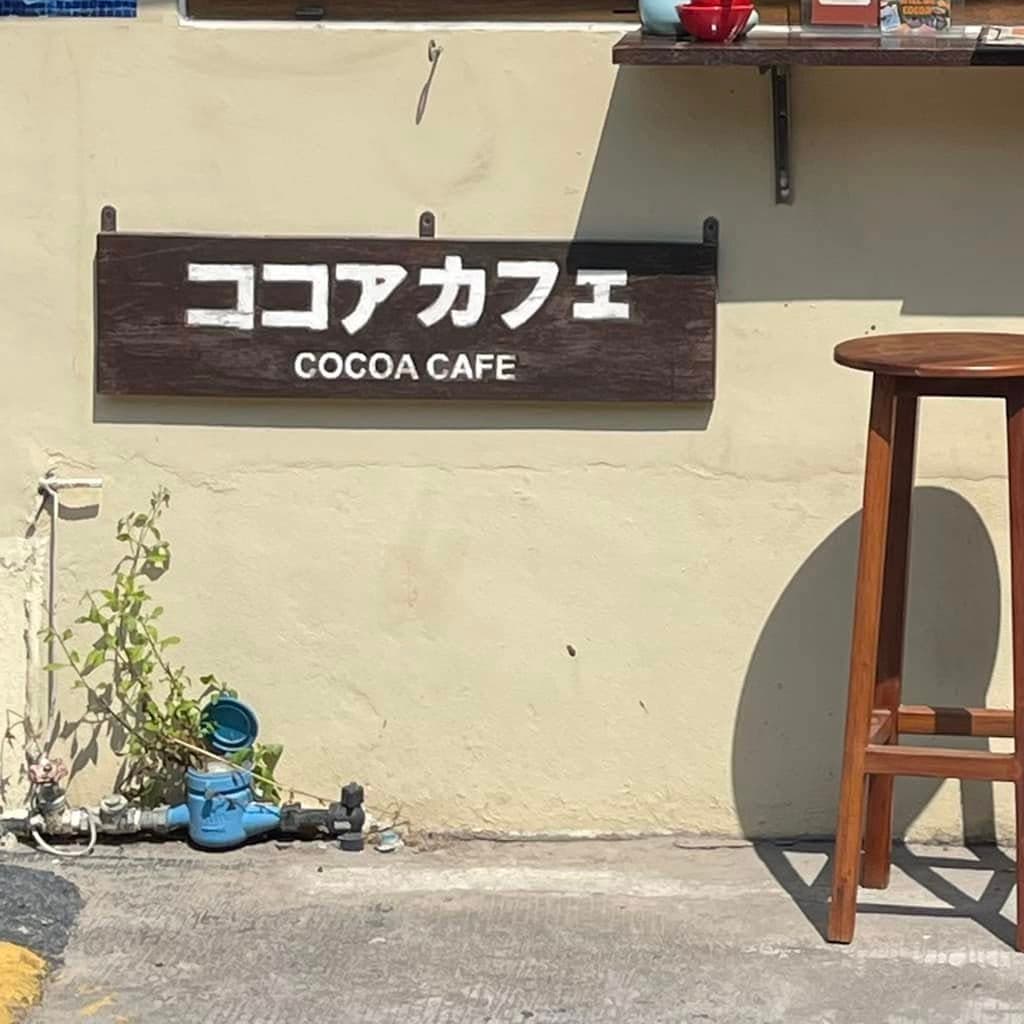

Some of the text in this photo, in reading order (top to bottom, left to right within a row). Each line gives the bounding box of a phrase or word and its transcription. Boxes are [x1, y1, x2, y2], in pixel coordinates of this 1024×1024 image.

[186, 255, 631, 336] ココアカフェ
[294, 353, 516, 381] COCOA CAFE
